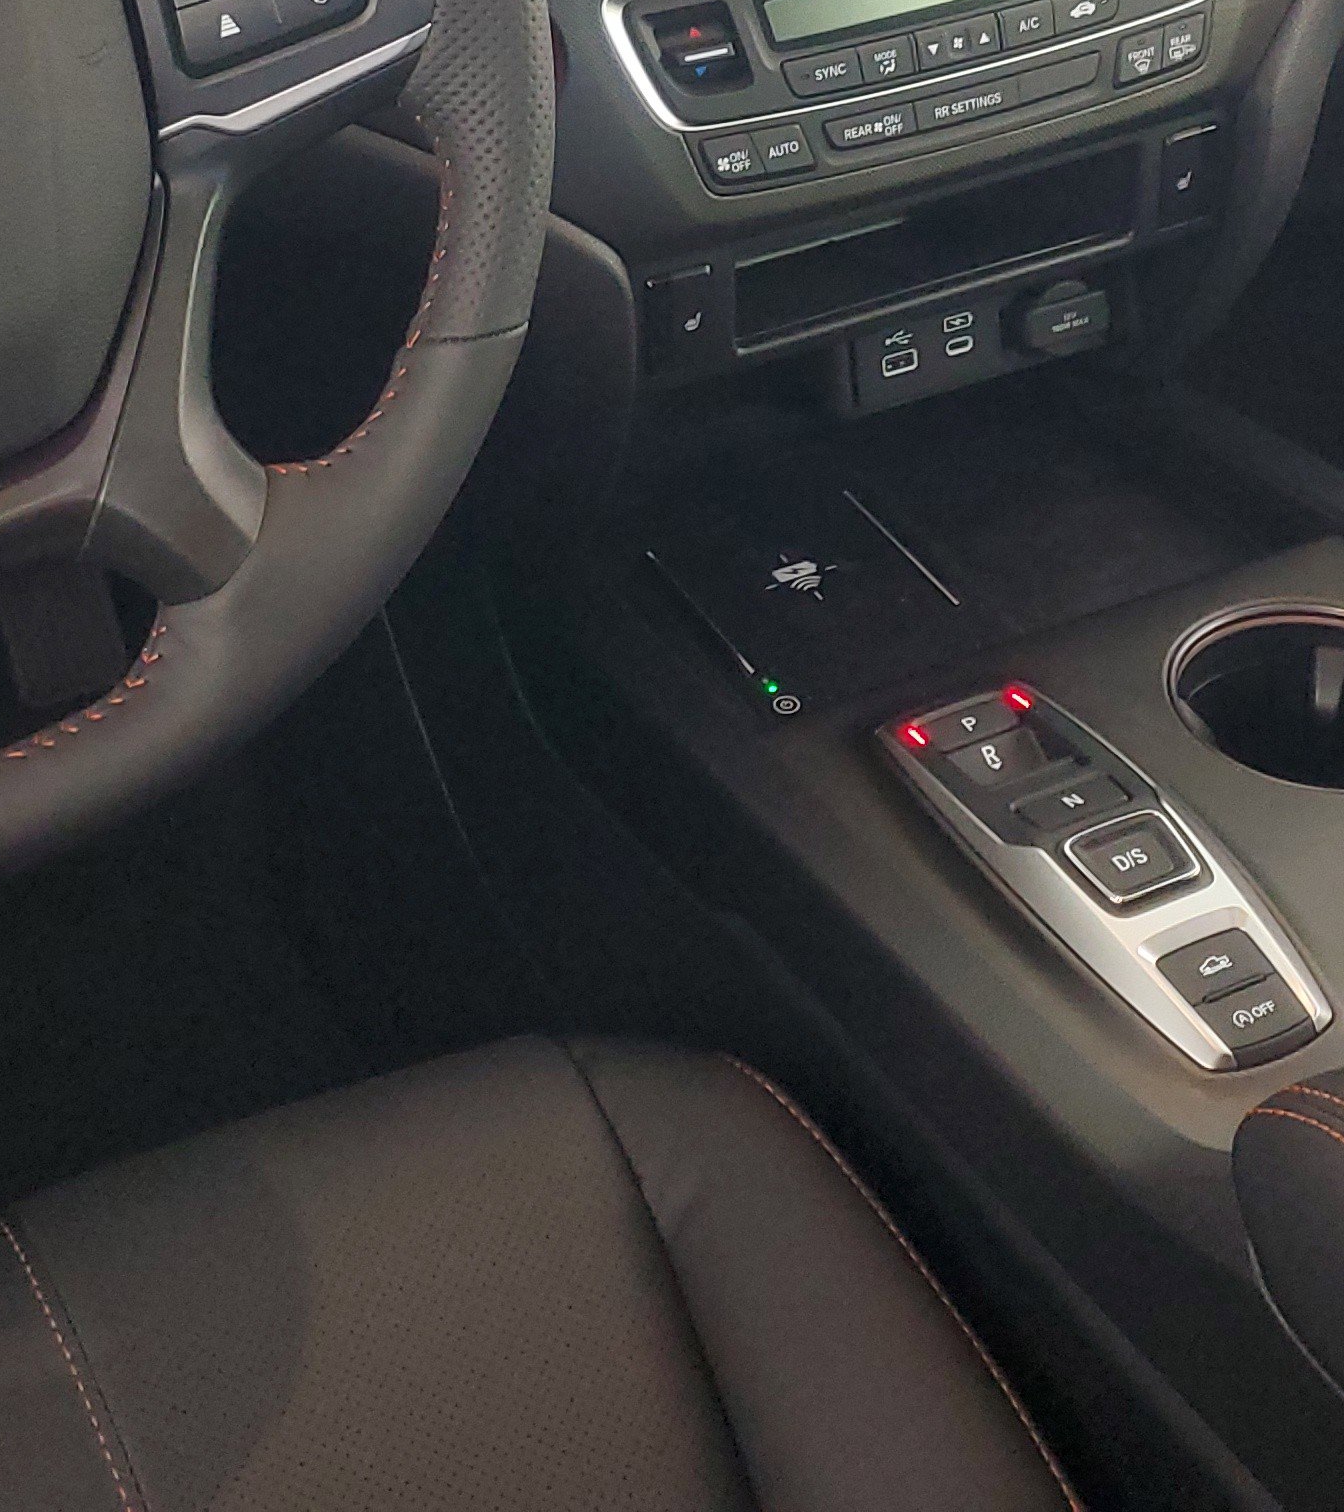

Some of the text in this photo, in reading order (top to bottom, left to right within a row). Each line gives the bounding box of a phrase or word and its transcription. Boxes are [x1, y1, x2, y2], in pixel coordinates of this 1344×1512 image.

[1019, 16, 1040, 33] A/C
[874, 49, 897, 62] MODE
[814, 63, 847, 81] SYNC
[934, 92, 1003, 120] RR SETTINGS
[883, 113, 902, 126] ON/
[844, 123, 873, 141] REAR
[884, 122, 904, 137] OFF
[729, 149, 749, 163] ON/
[769, 140, 799, 160] AUTO
[731, 158, 752, 173] OFF
[960, 715, 977, 732] P
[981, 744, 998, 766] R
[1061, 792, 1085, 809] N
[1111, 847, 1149, 873] D/S
[1251, 999, 1276, 1018] OFF
